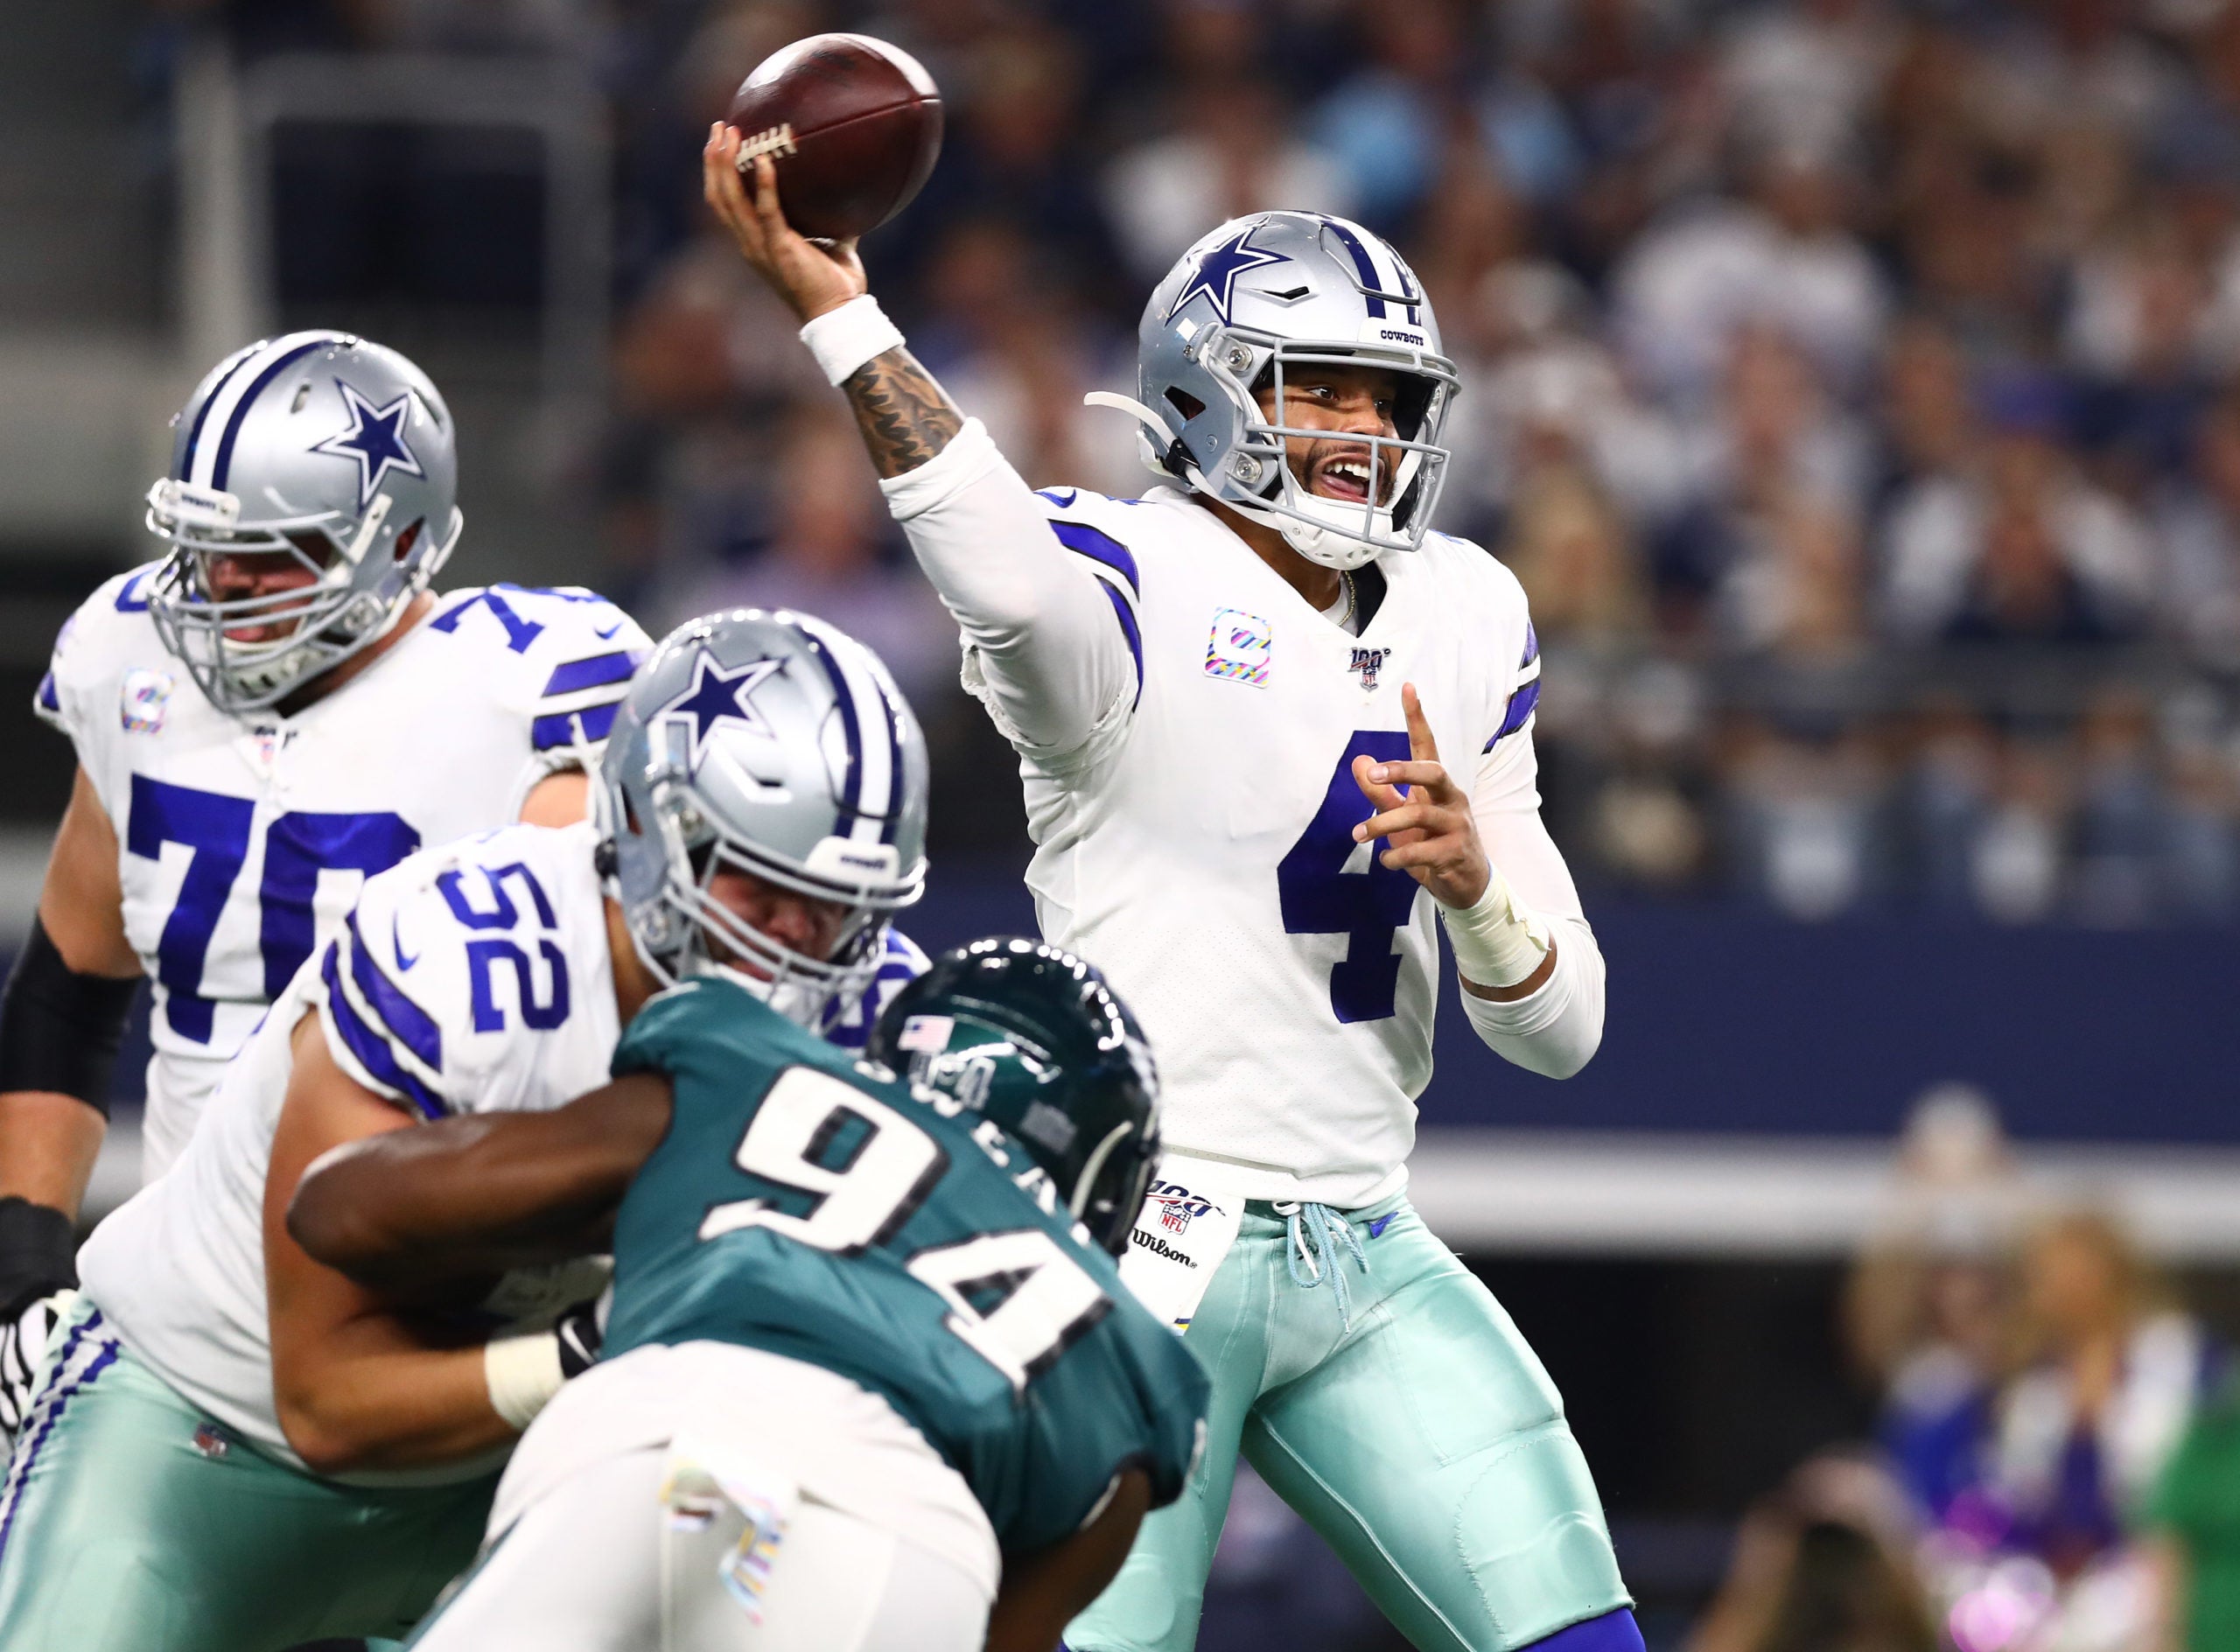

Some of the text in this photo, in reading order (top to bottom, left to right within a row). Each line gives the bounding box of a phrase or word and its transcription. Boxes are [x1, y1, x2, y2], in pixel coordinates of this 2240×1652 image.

[1381, 330, 1424, 346] COWBOYS
[1213, 612, 1271, 668] C
[1278, 729, 1428, 1025] 4
[436, 861, 571, 1034] 52
[698, 1064, 1113, 1391] 94
[1132, 1227, 1193, 1268] Wilson
[1161, 1213, 1183, 1233] NFL
